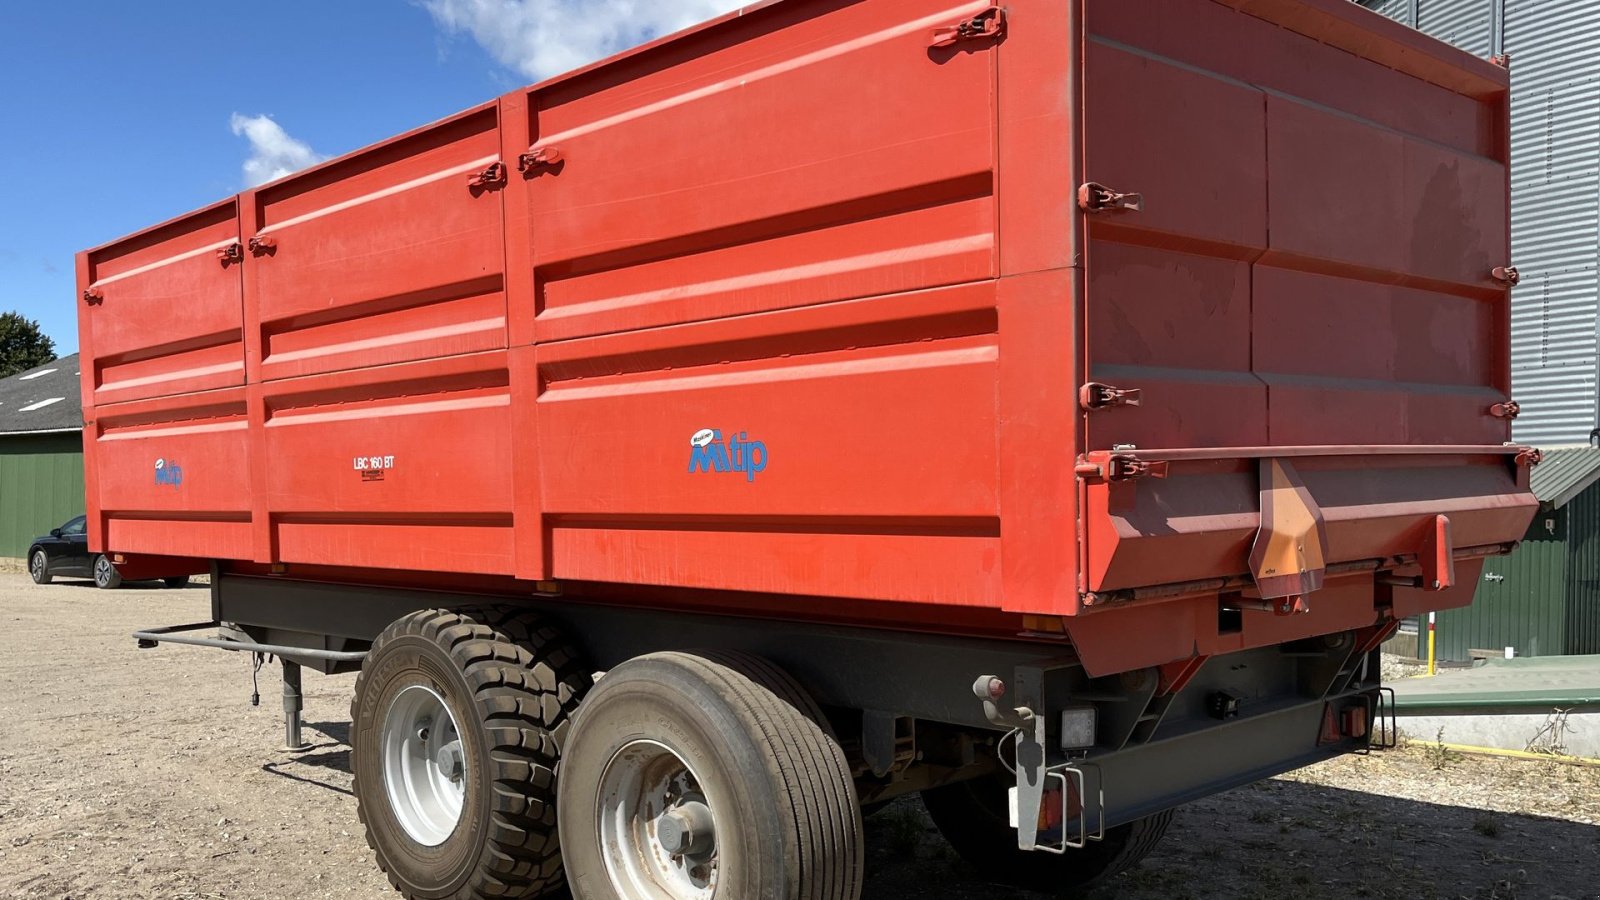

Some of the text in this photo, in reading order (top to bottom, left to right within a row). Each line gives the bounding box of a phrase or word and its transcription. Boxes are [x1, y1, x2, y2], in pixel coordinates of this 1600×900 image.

[353, 455, 395, 470] LBC 160 BT
